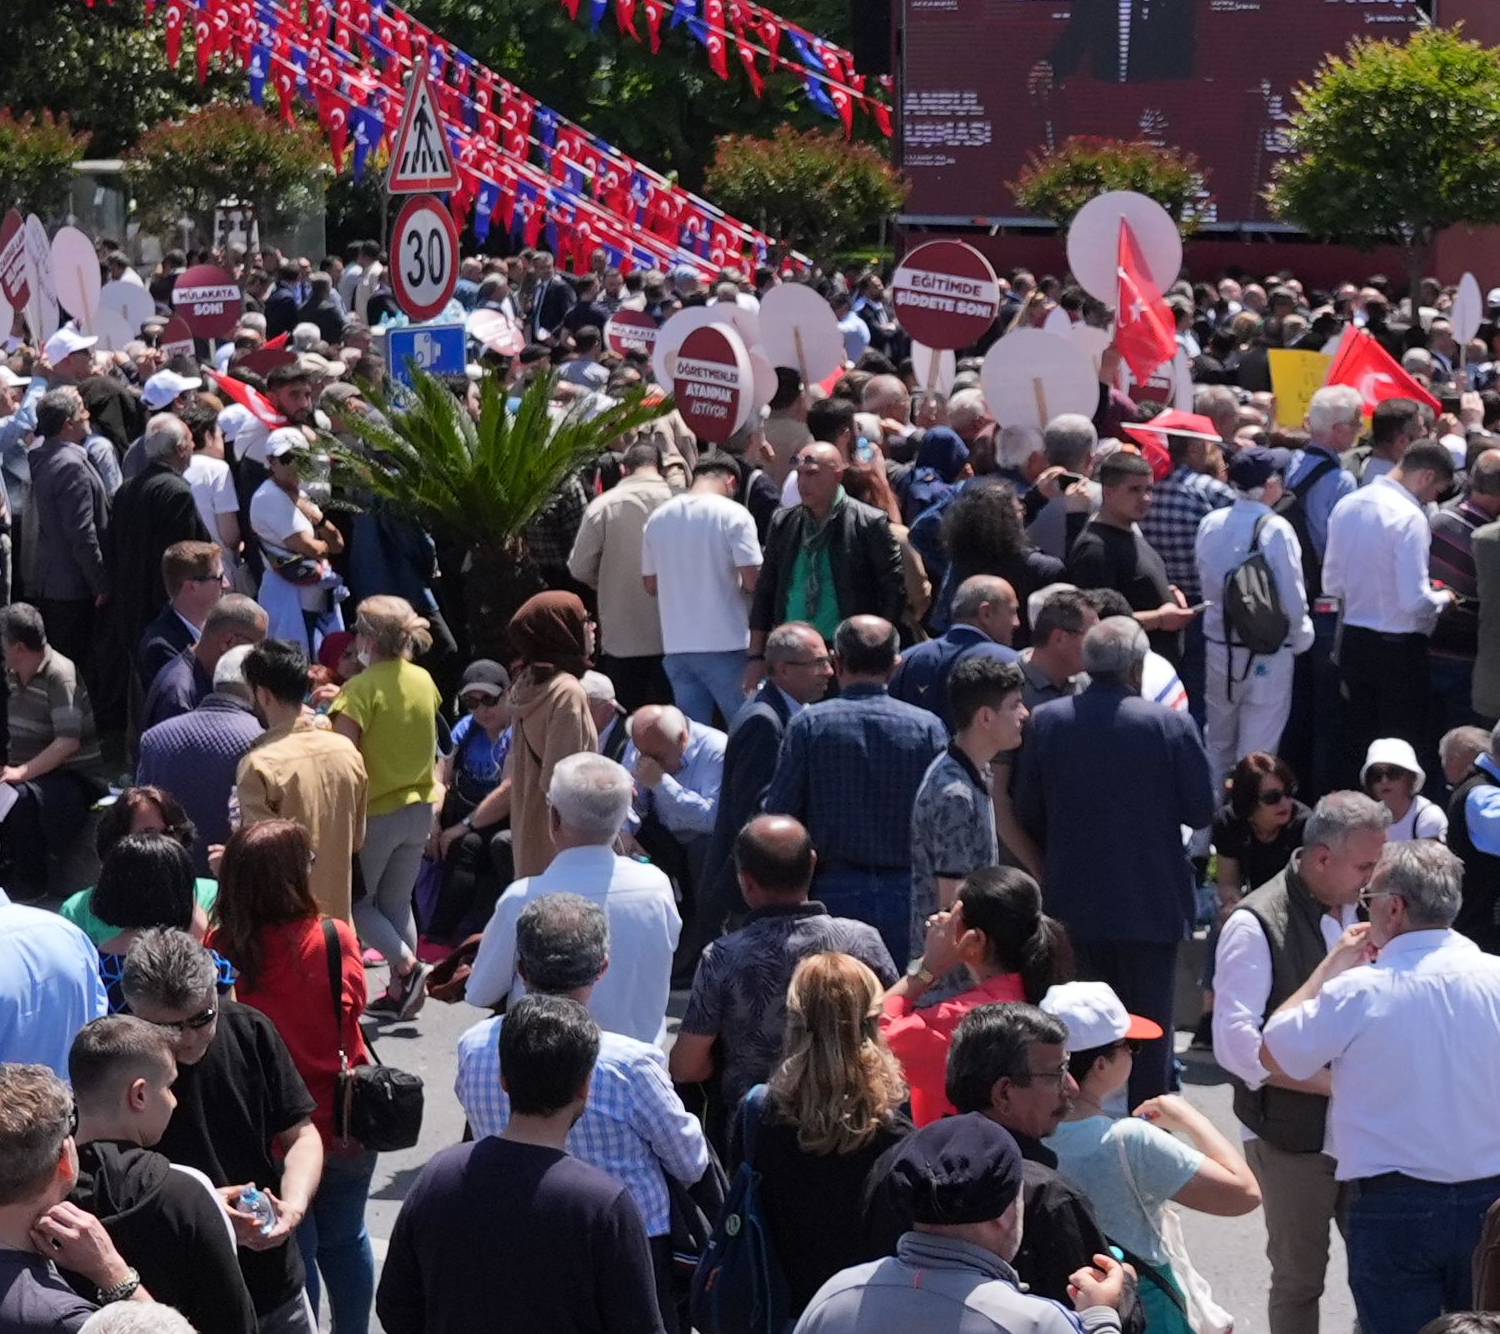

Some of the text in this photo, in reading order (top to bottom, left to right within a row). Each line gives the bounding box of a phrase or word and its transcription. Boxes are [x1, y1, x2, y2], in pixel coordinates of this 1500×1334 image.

[407, 228, 445, 287] 30
[179, 289, 235, 300] MÜLAKATA
[911, 274, 983, 297] EĞİTİMDE
[194, 303, 224, 316] SON!
[896, 290, 956, 312] ŞİDDETE
[685, 382, 732, 403] ATANMAK
